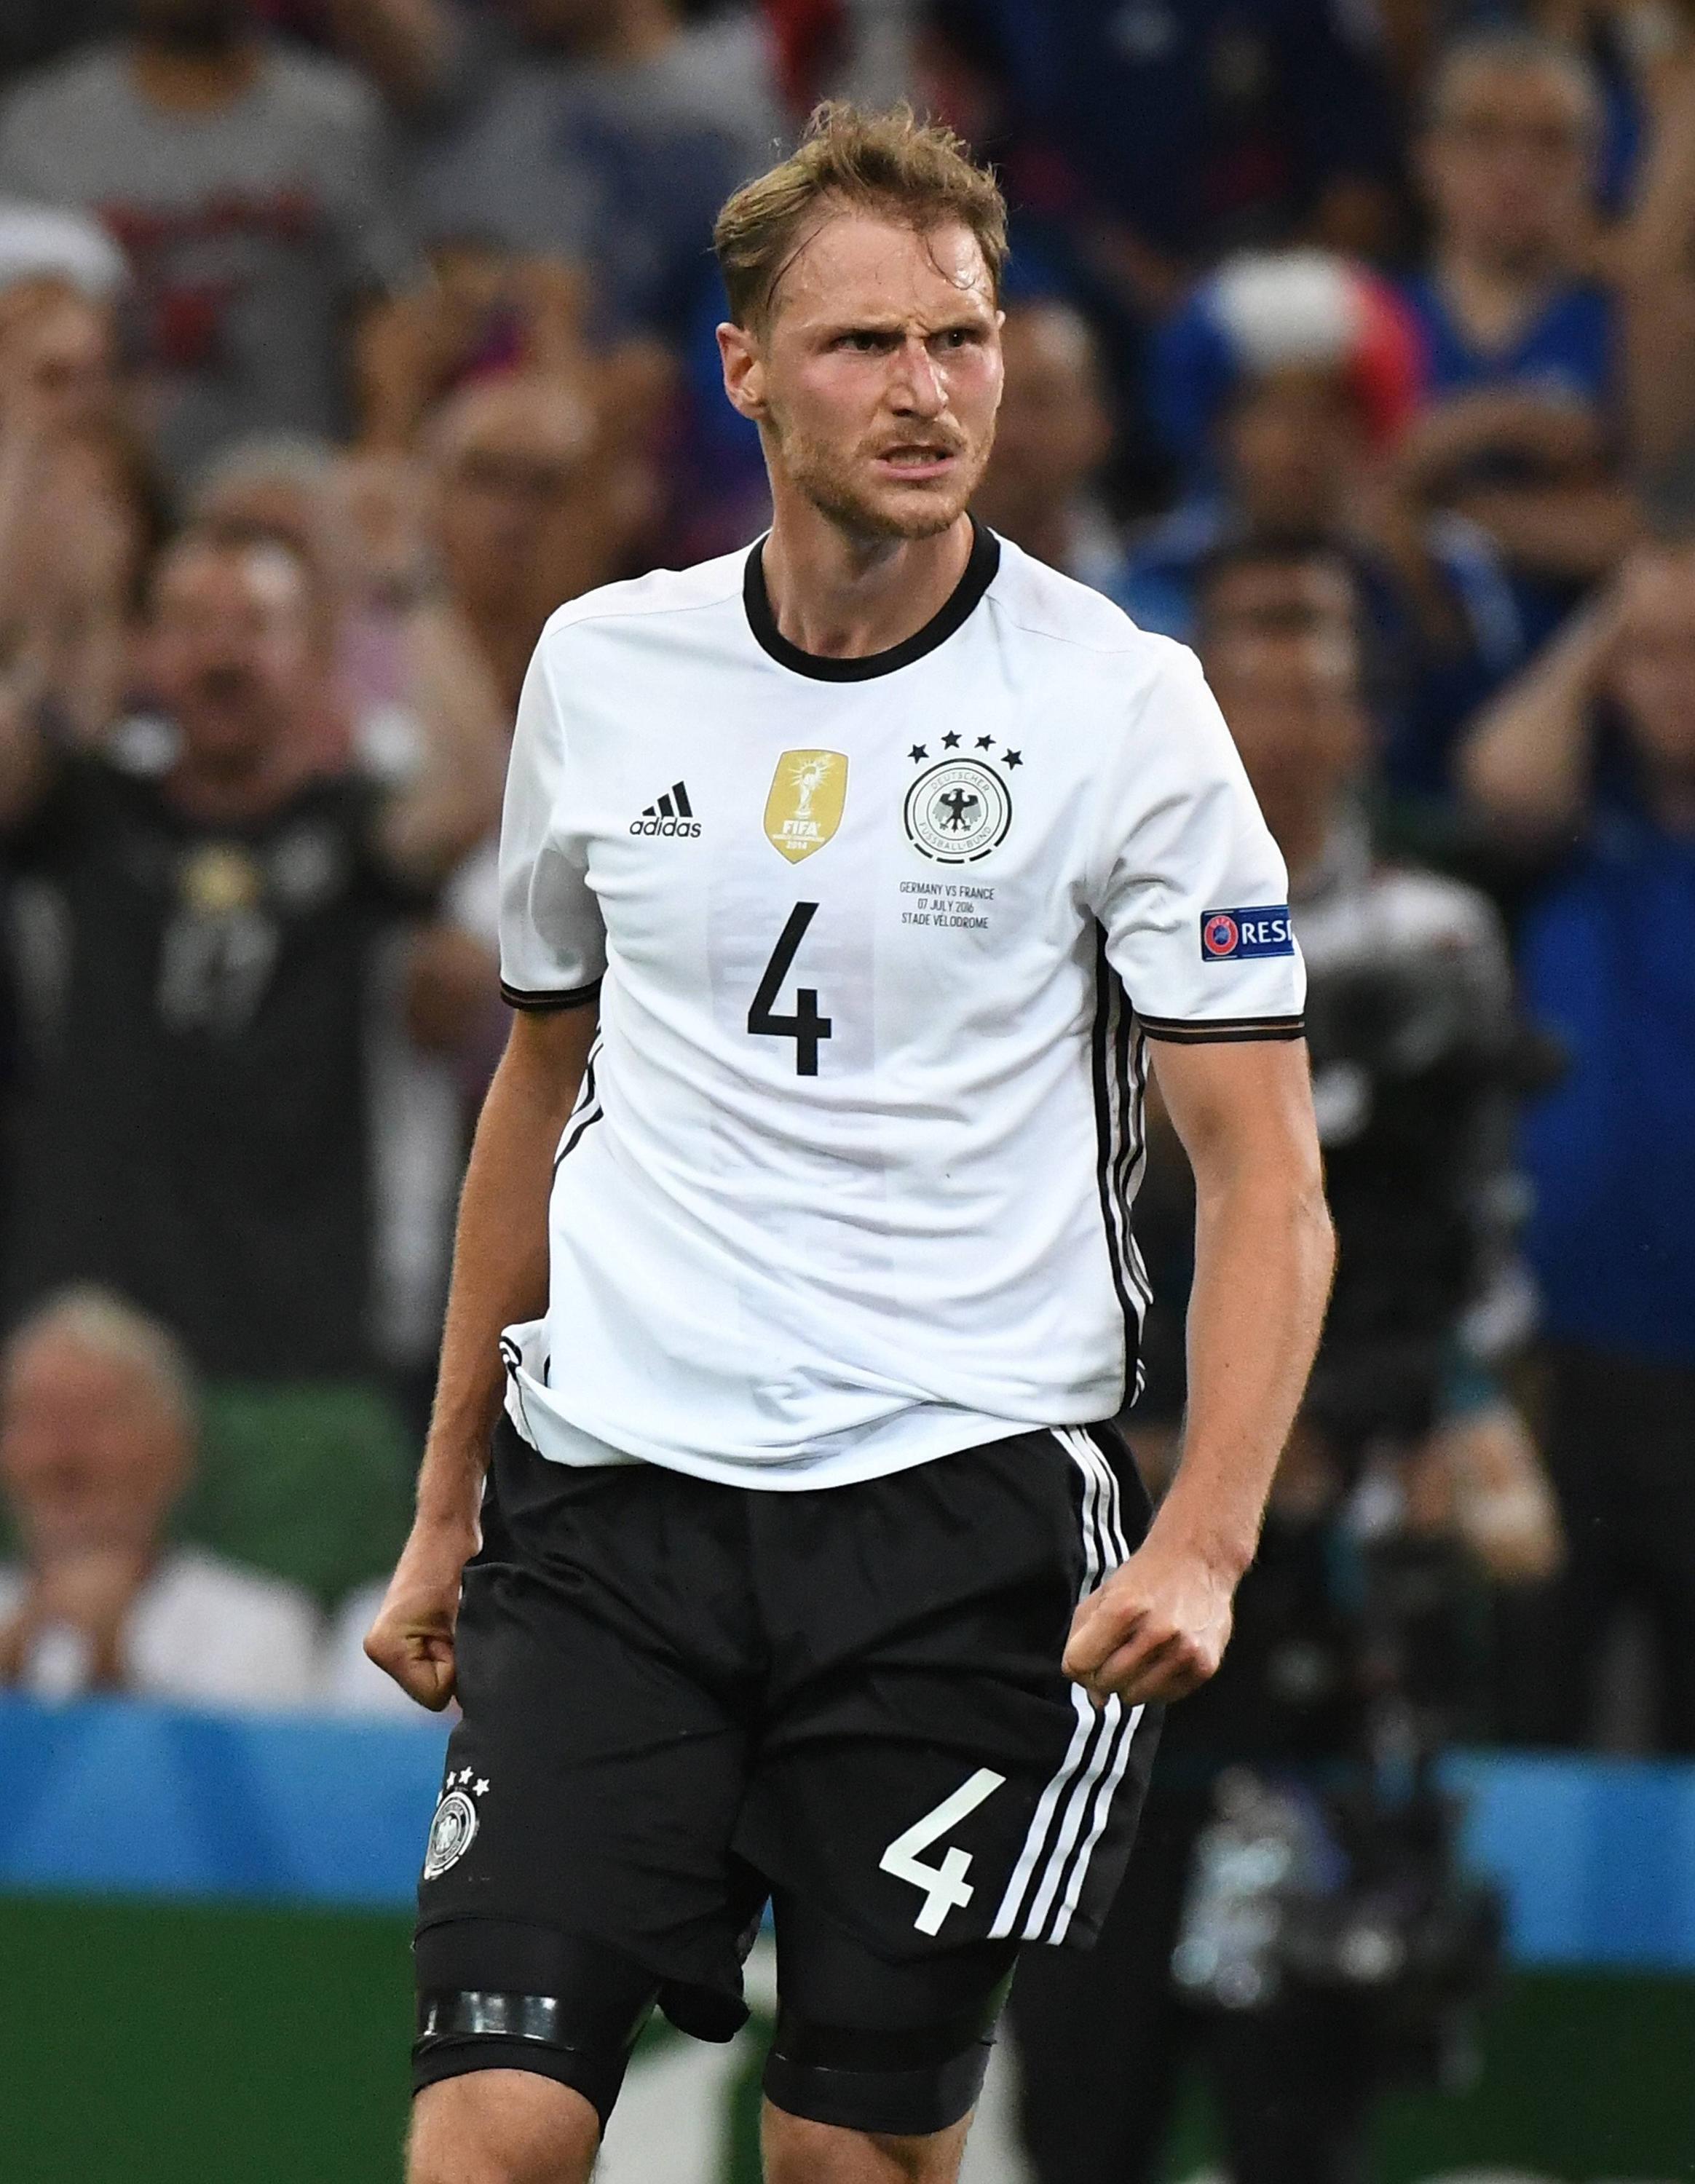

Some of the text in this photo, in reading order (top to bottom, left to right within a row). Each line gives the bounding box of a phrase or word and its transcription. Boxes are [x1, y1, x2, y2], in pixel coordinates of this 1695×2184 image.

[931, 771, 990, 792] DEUTSCHER
[629, 817, 702, 838] adidas
[783, 820, 818, 837] FIFA
[899, 882, 995, 900] GERMANY VS FRANCE
[917, 898, 974, 913] 07 JULY 2016
[901, 912, 931, 925] STADE
[747, 901, 831, 1076] 4
[879, 1767, 1006, 1936] 4
